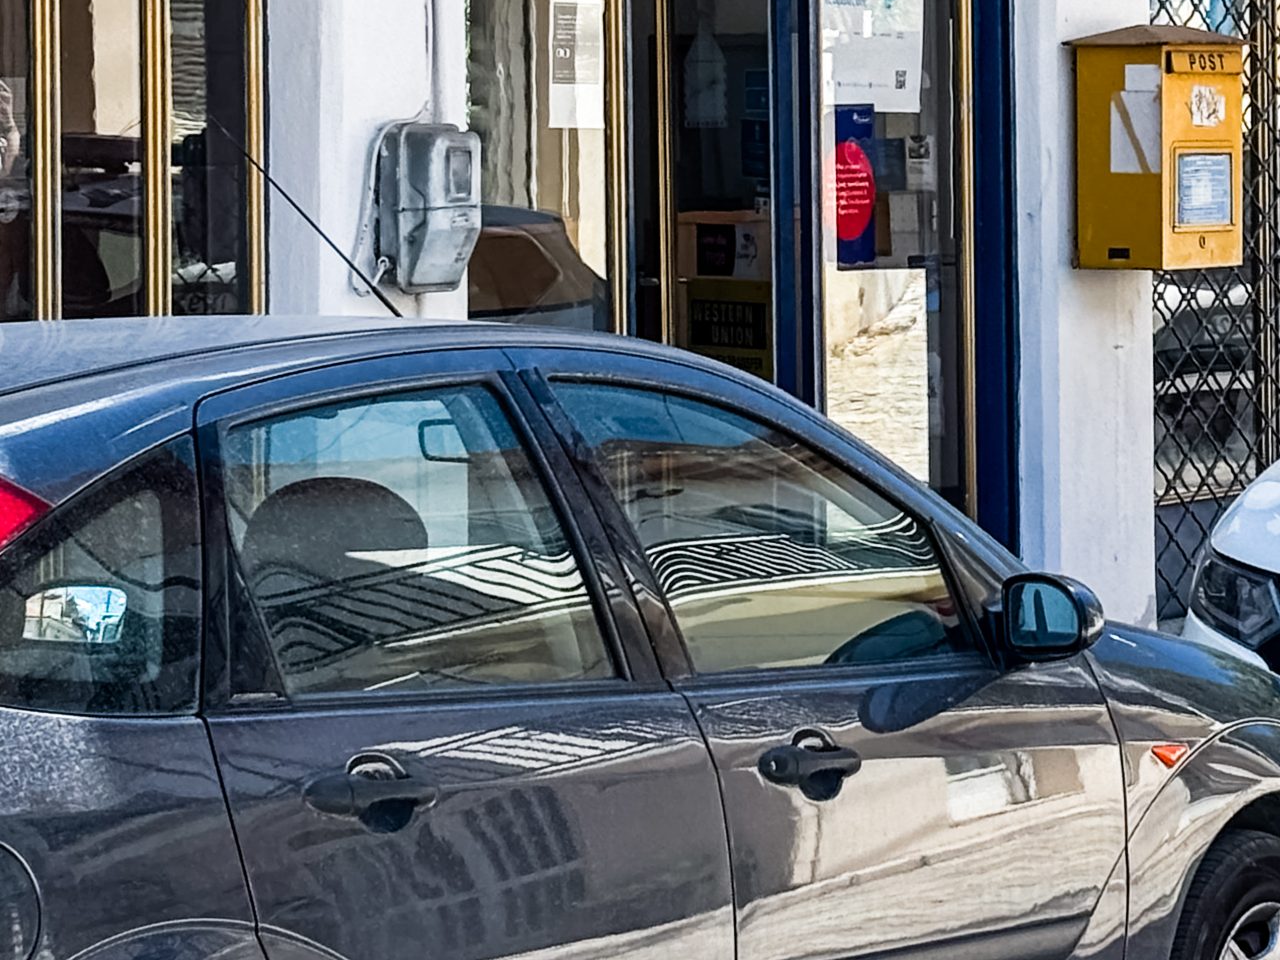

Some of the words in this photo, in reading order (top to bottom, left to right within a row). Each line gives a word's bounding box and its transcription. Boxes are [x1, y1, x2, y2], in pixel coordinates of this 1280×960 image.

[1188, 53, 1226, 71] POST
[693, 302, 753, 324] WESTERN
[711, 324, 753, 346] UNION
